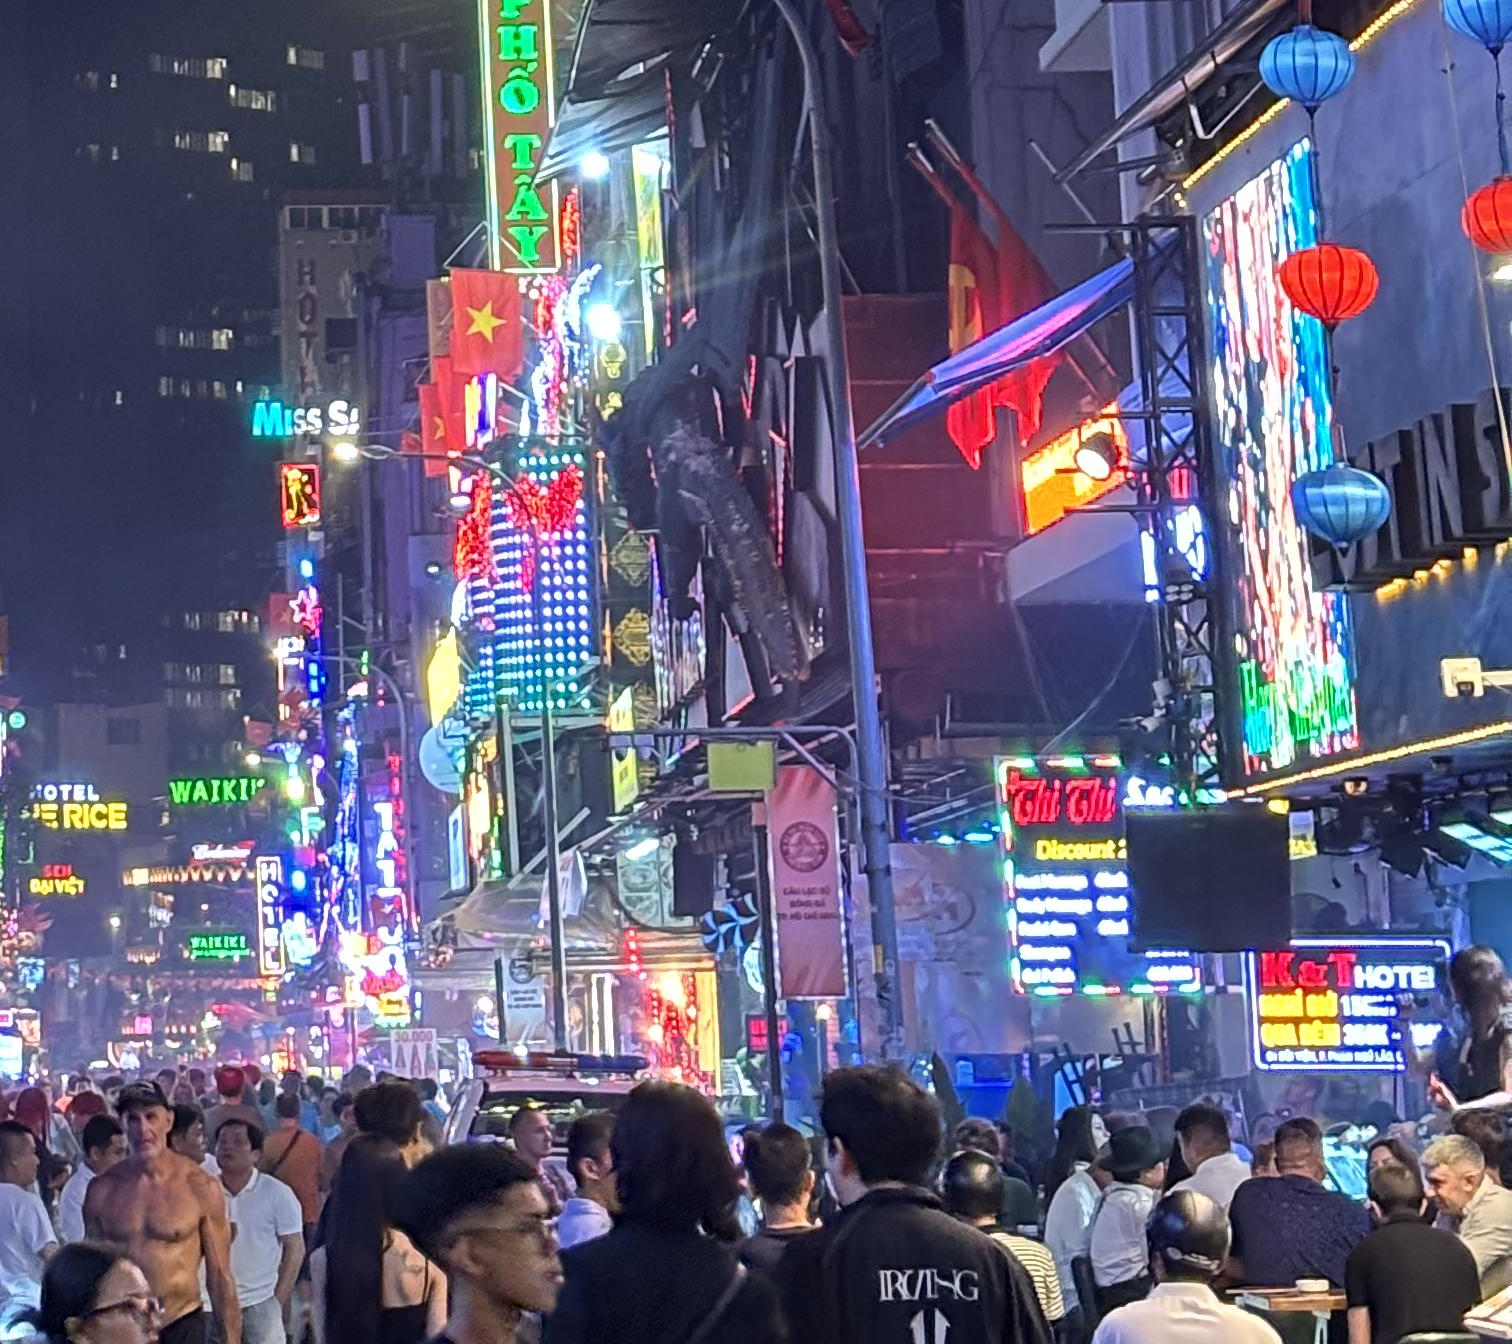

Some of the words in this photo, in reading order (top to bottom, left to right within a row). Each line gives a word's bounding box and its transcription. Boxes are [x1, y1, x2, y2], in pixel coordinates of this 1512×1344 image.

[62, 802, 128, 830] RICE
[1036, 838, 1116, 860] Discount
[261, 862, 280, 969] HOTEL
[190, 935, 246, 949] WAIKIKI
[876, 1268, 979, 1302] IRVING
